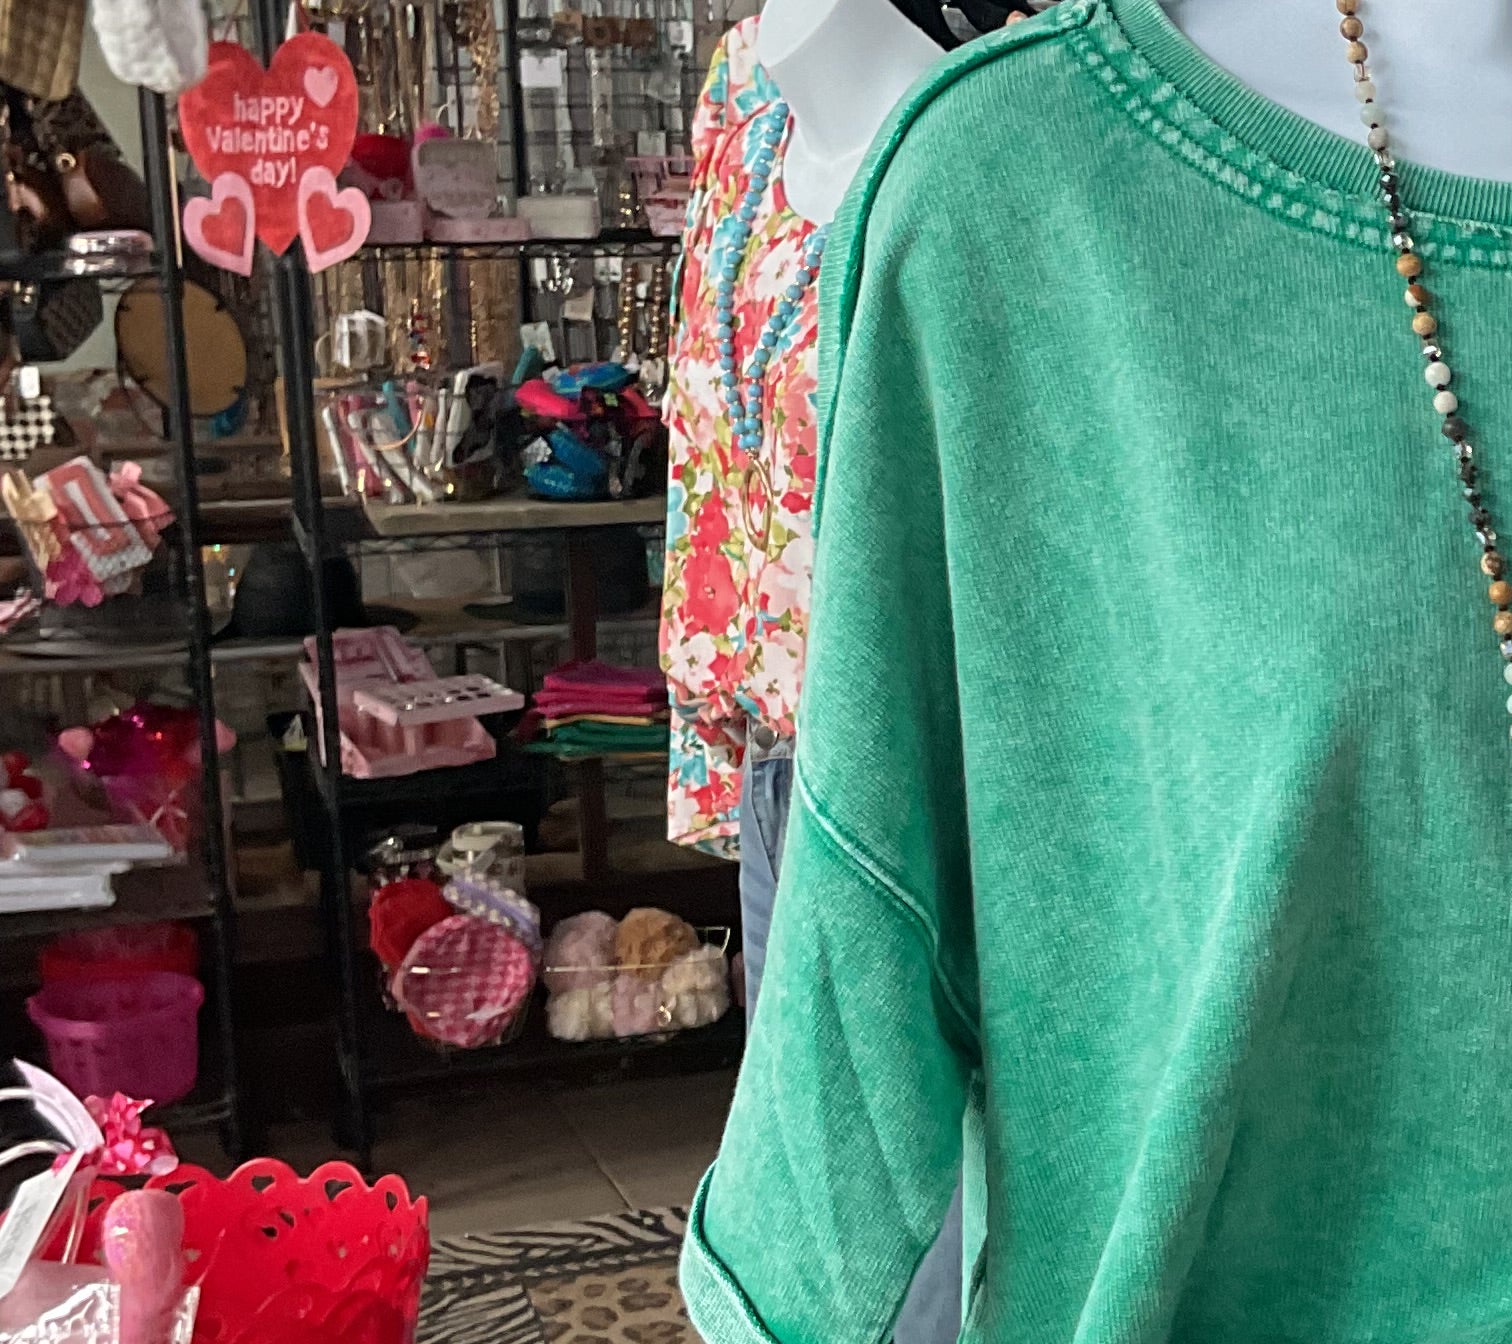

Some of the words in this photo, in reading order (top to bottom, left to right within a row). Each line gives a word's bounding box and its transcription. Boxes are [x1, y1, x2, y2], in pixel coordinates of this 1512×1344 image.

[233, 92, 305, 126] happy
[205, 121, 330, 154] Valentine's
[250, 156, 297, 189] day!
